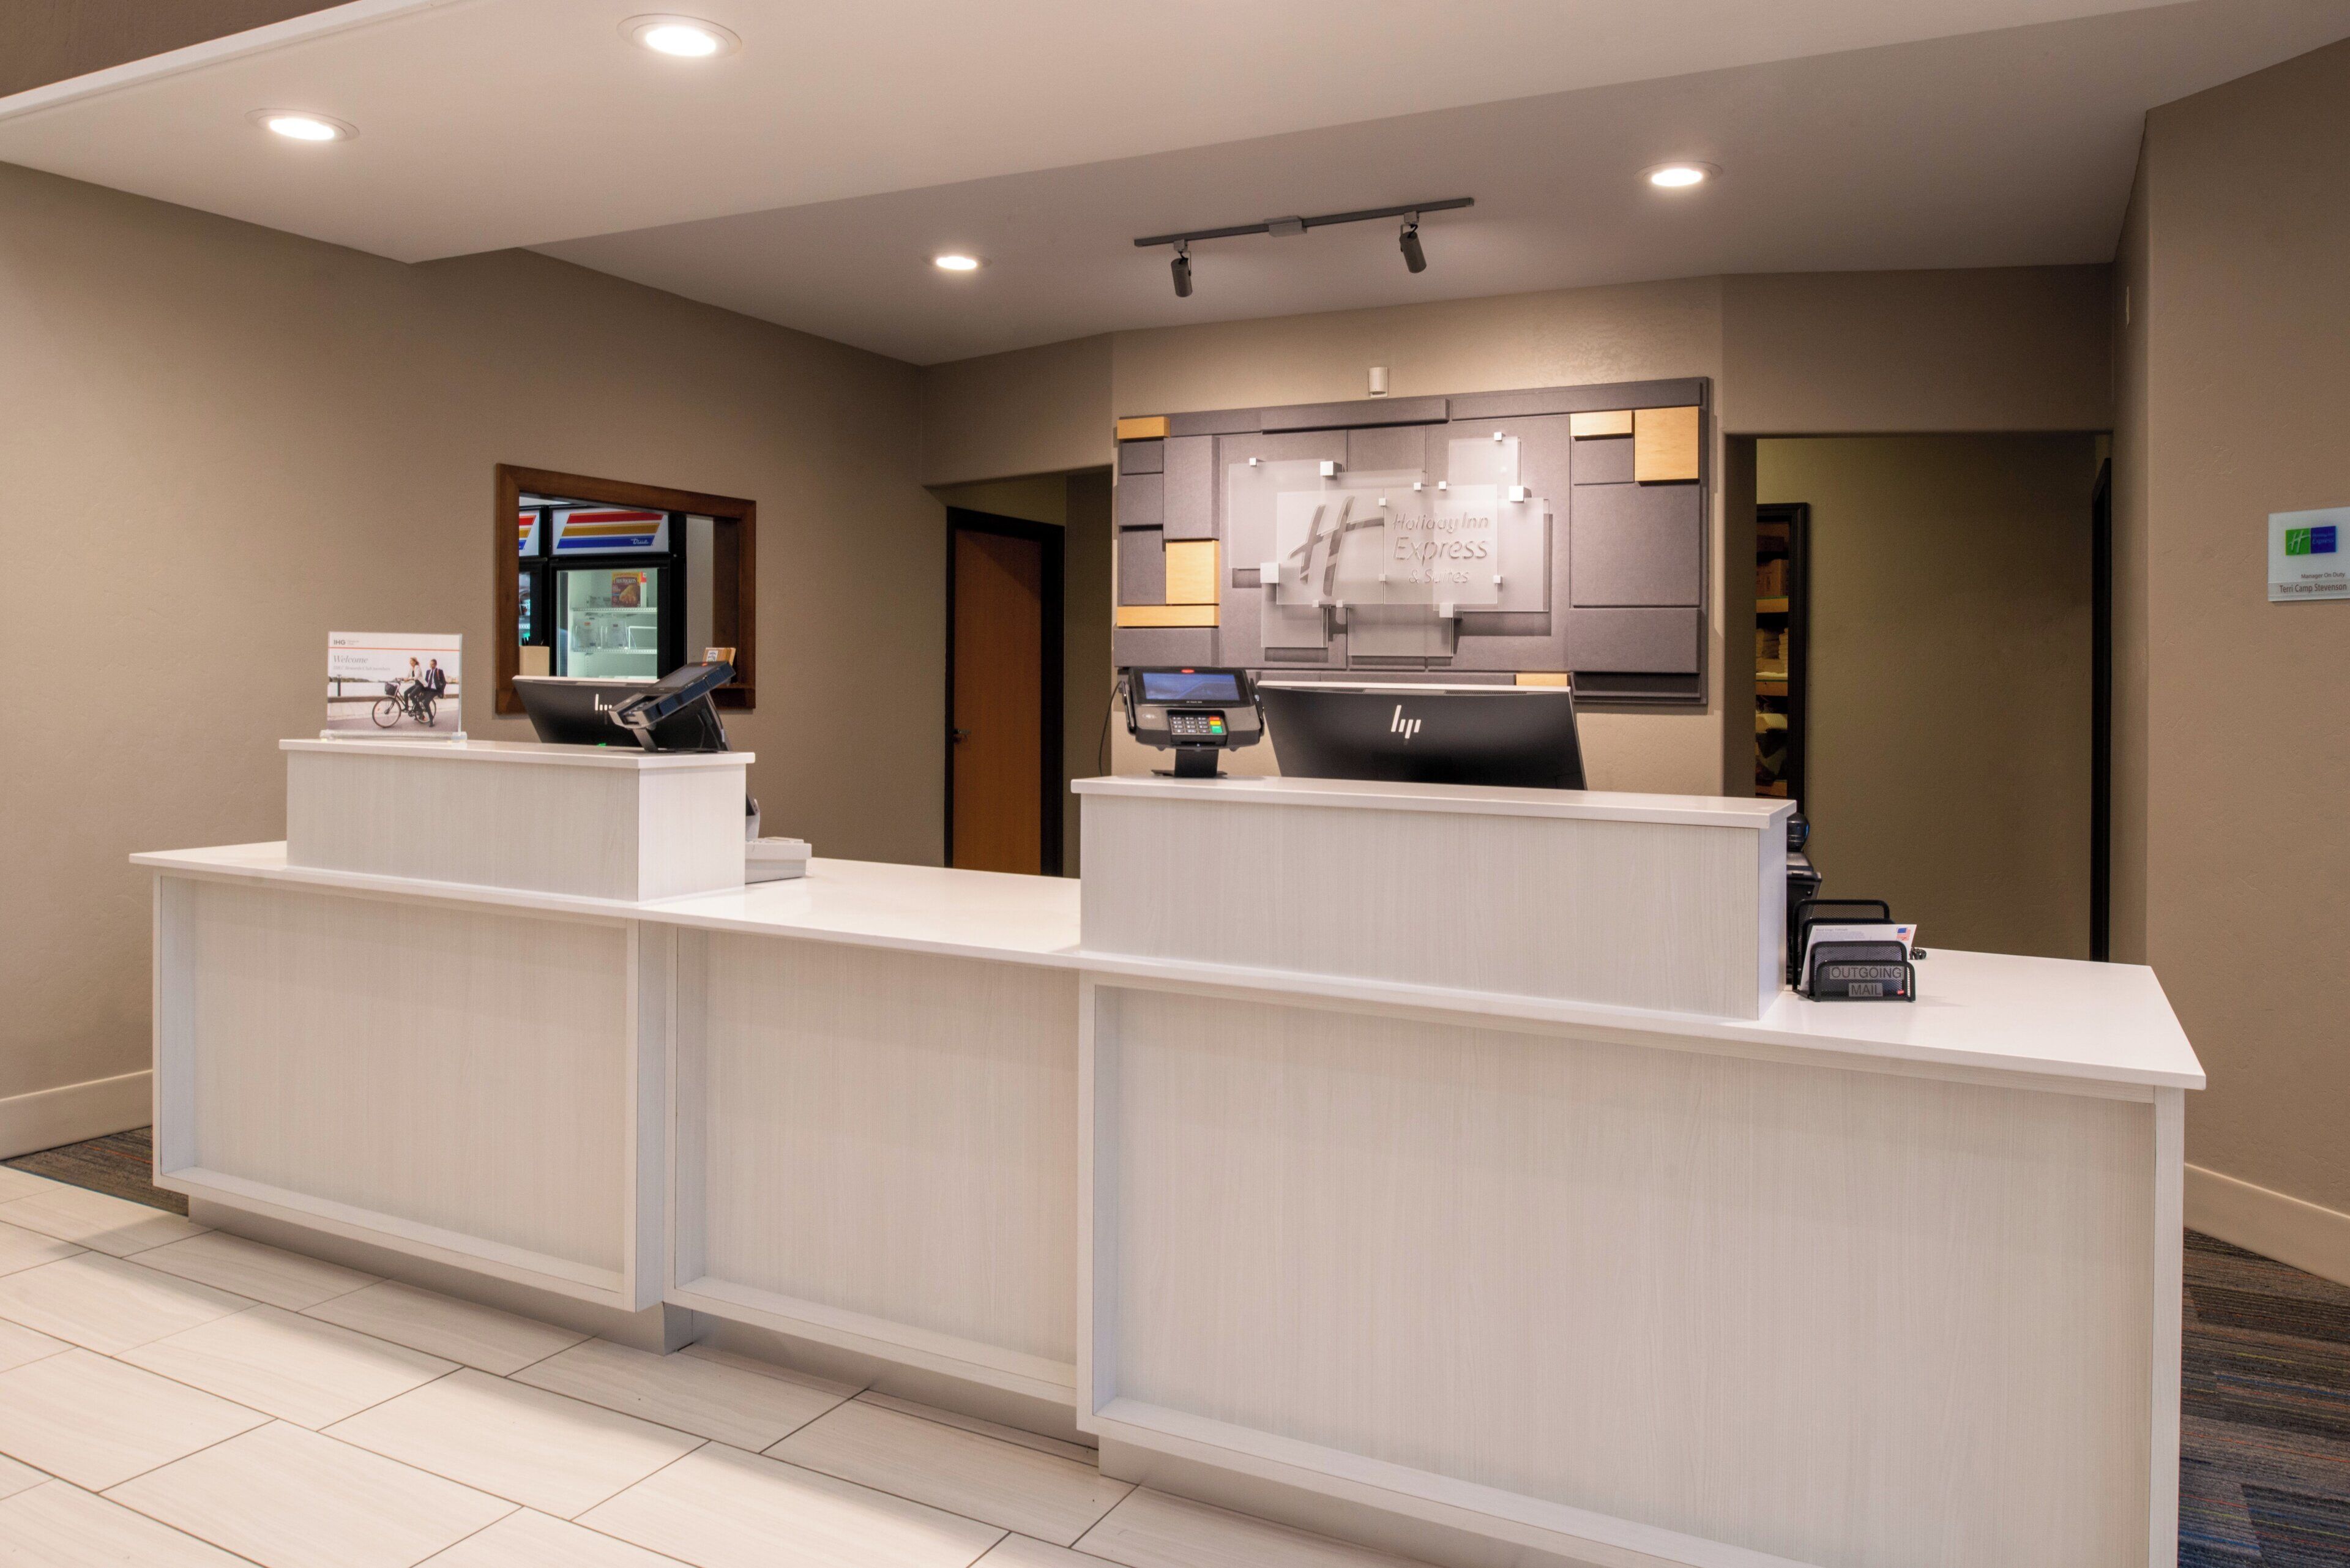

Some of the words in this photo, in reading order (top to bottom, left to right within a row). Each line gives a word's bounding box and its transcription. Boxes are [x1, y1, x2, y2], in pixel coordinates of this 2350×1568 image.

[1393, 513, 1460, 533] Holiday
[1461, 512, 1489, 529] Inn
[1393, 536, 1488, 566] Express
[1409, 569, 1420, 583] &
[1424, 568, 1469, 583] Suites
[2280, 584, 2293, 593] Terri
[2294, 584, 2313, 593] Camp
[2314, 583, 2348, 592] Stevenson
[334, 655, 368, 664] Welcome
[1390, 704, 1422, 739] hp
[1830, 967, 1902, 979] OUTGOING
[1851, 984, 1882, 995] MAIL
